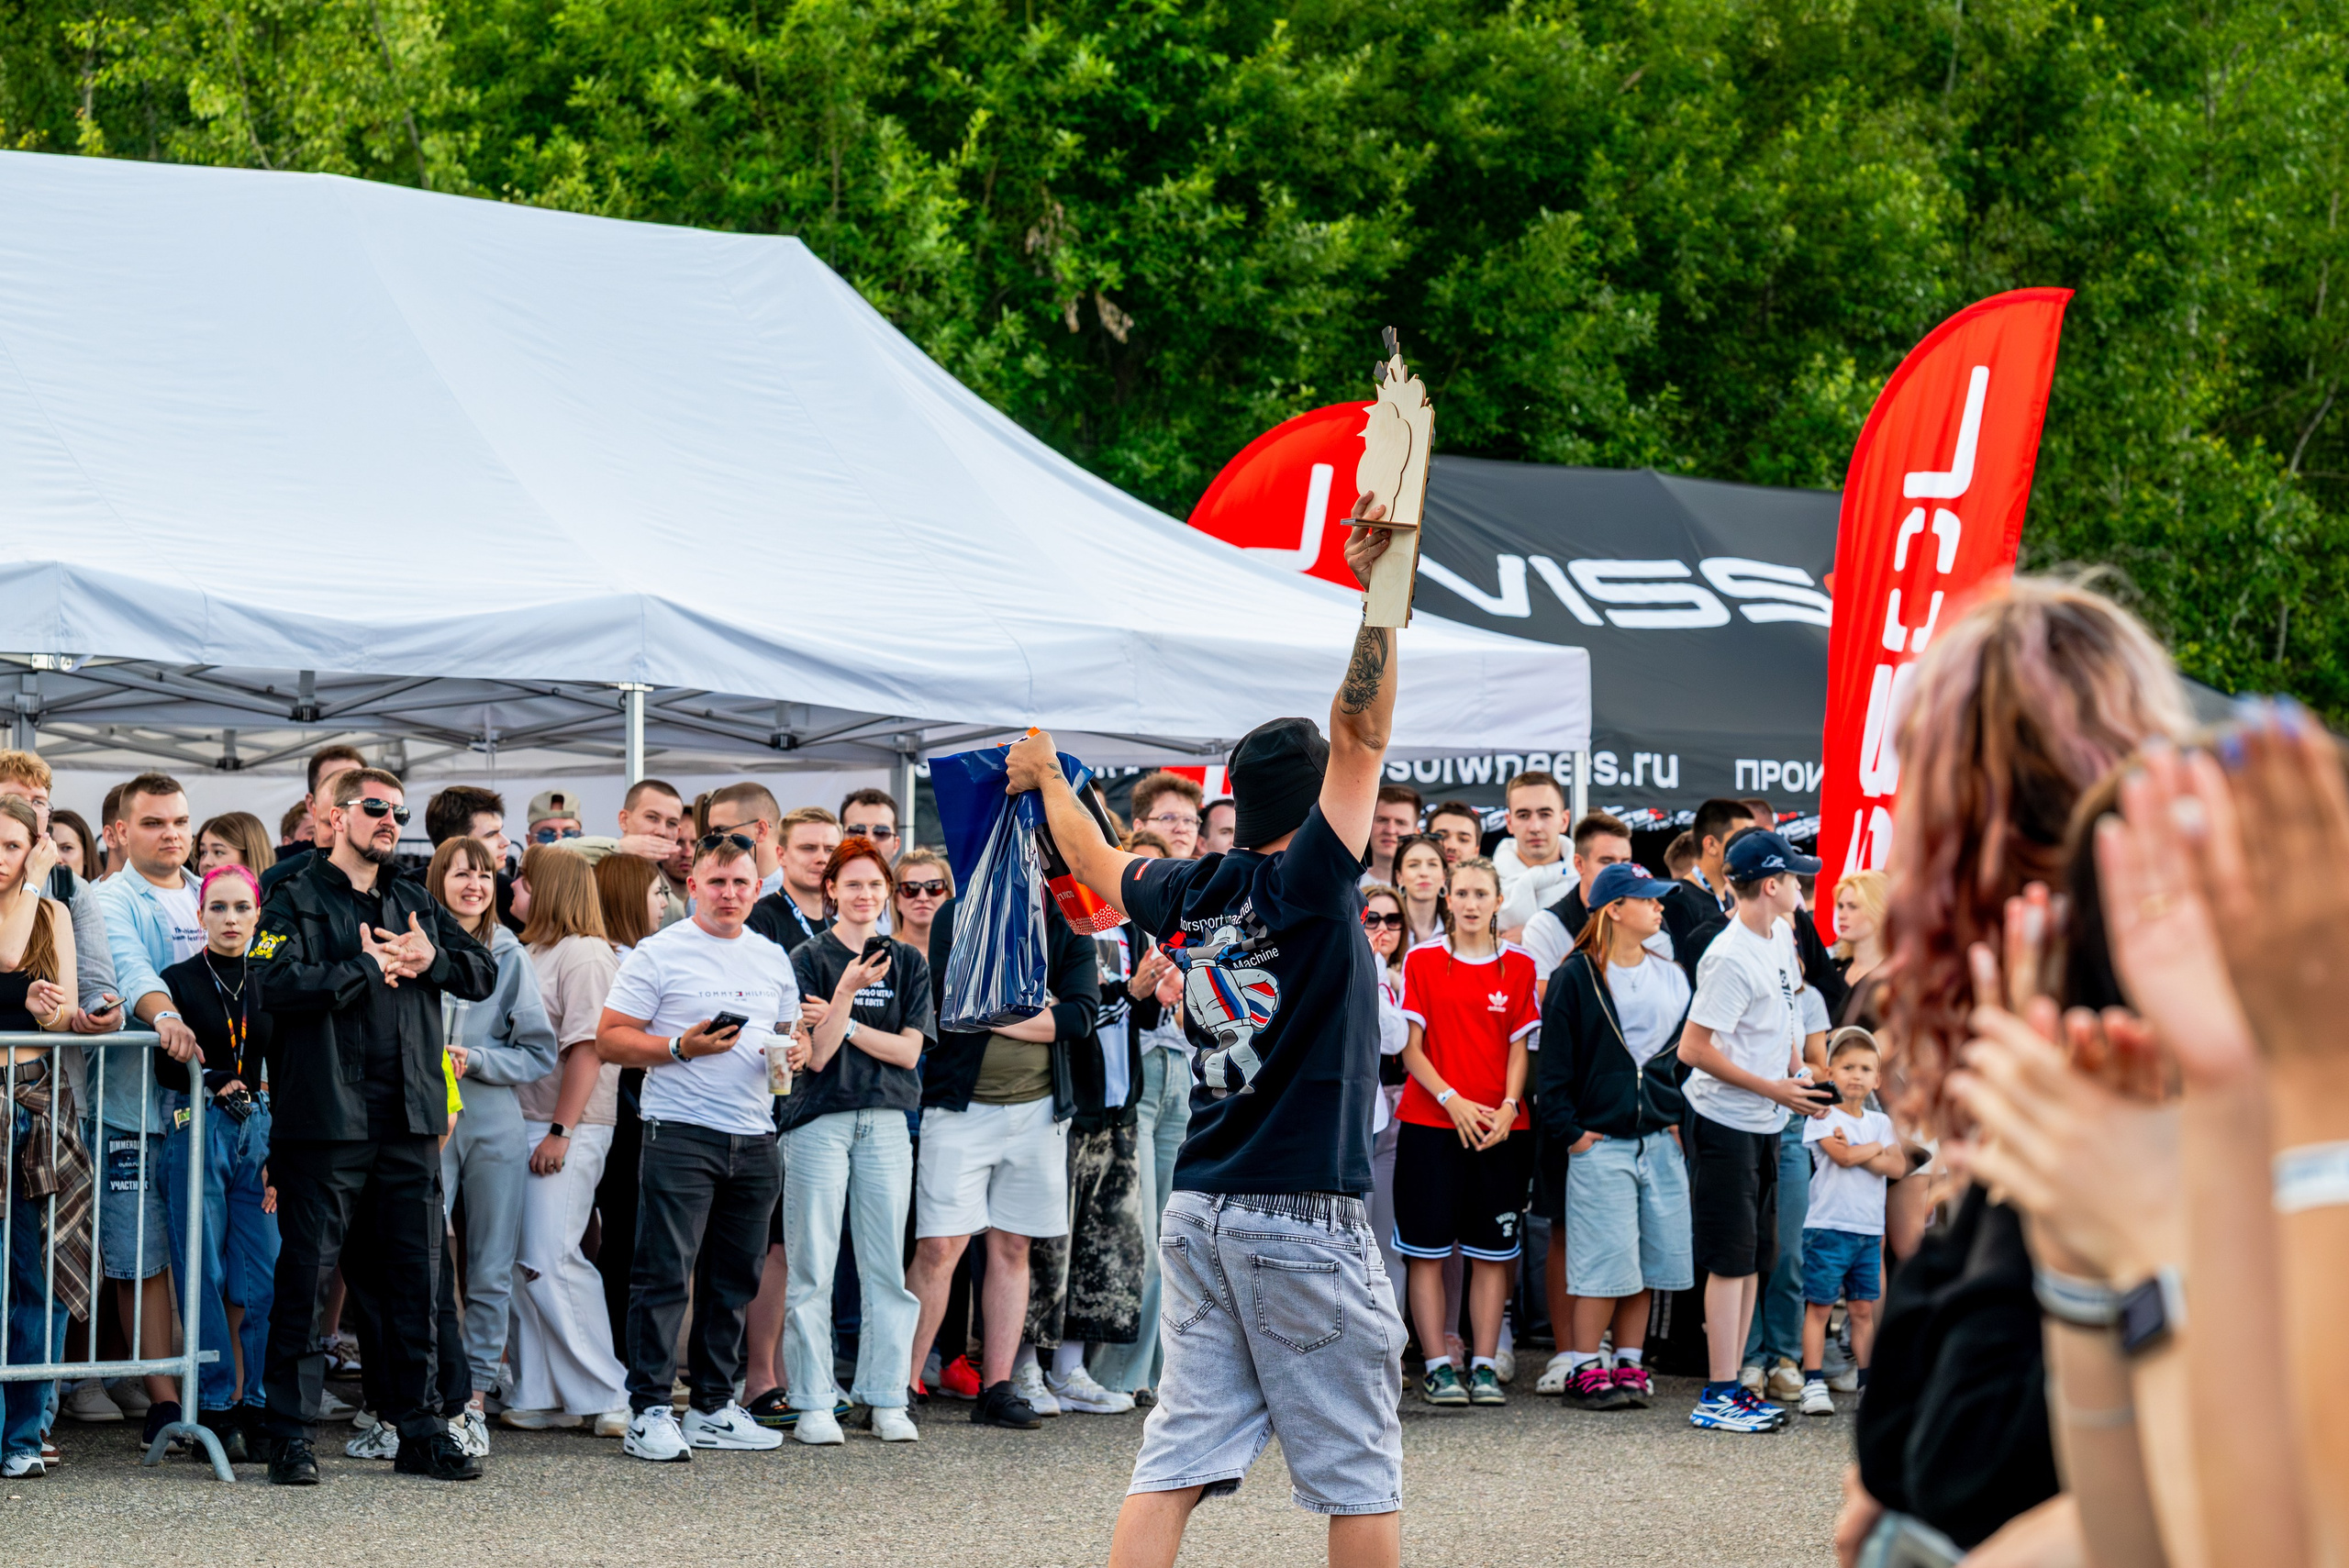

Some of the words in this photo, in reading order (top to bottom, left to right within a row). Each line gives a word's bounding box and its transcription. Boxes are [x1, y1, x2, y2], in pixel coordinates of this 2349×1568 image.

[1419, 553, 1833, 628] VISS
[1735, 758, 1824, 793] ПРОИ
[1232, 947, 1280, 969] Machine
[110, 1180, 149, 1191] УЧАСТНК
